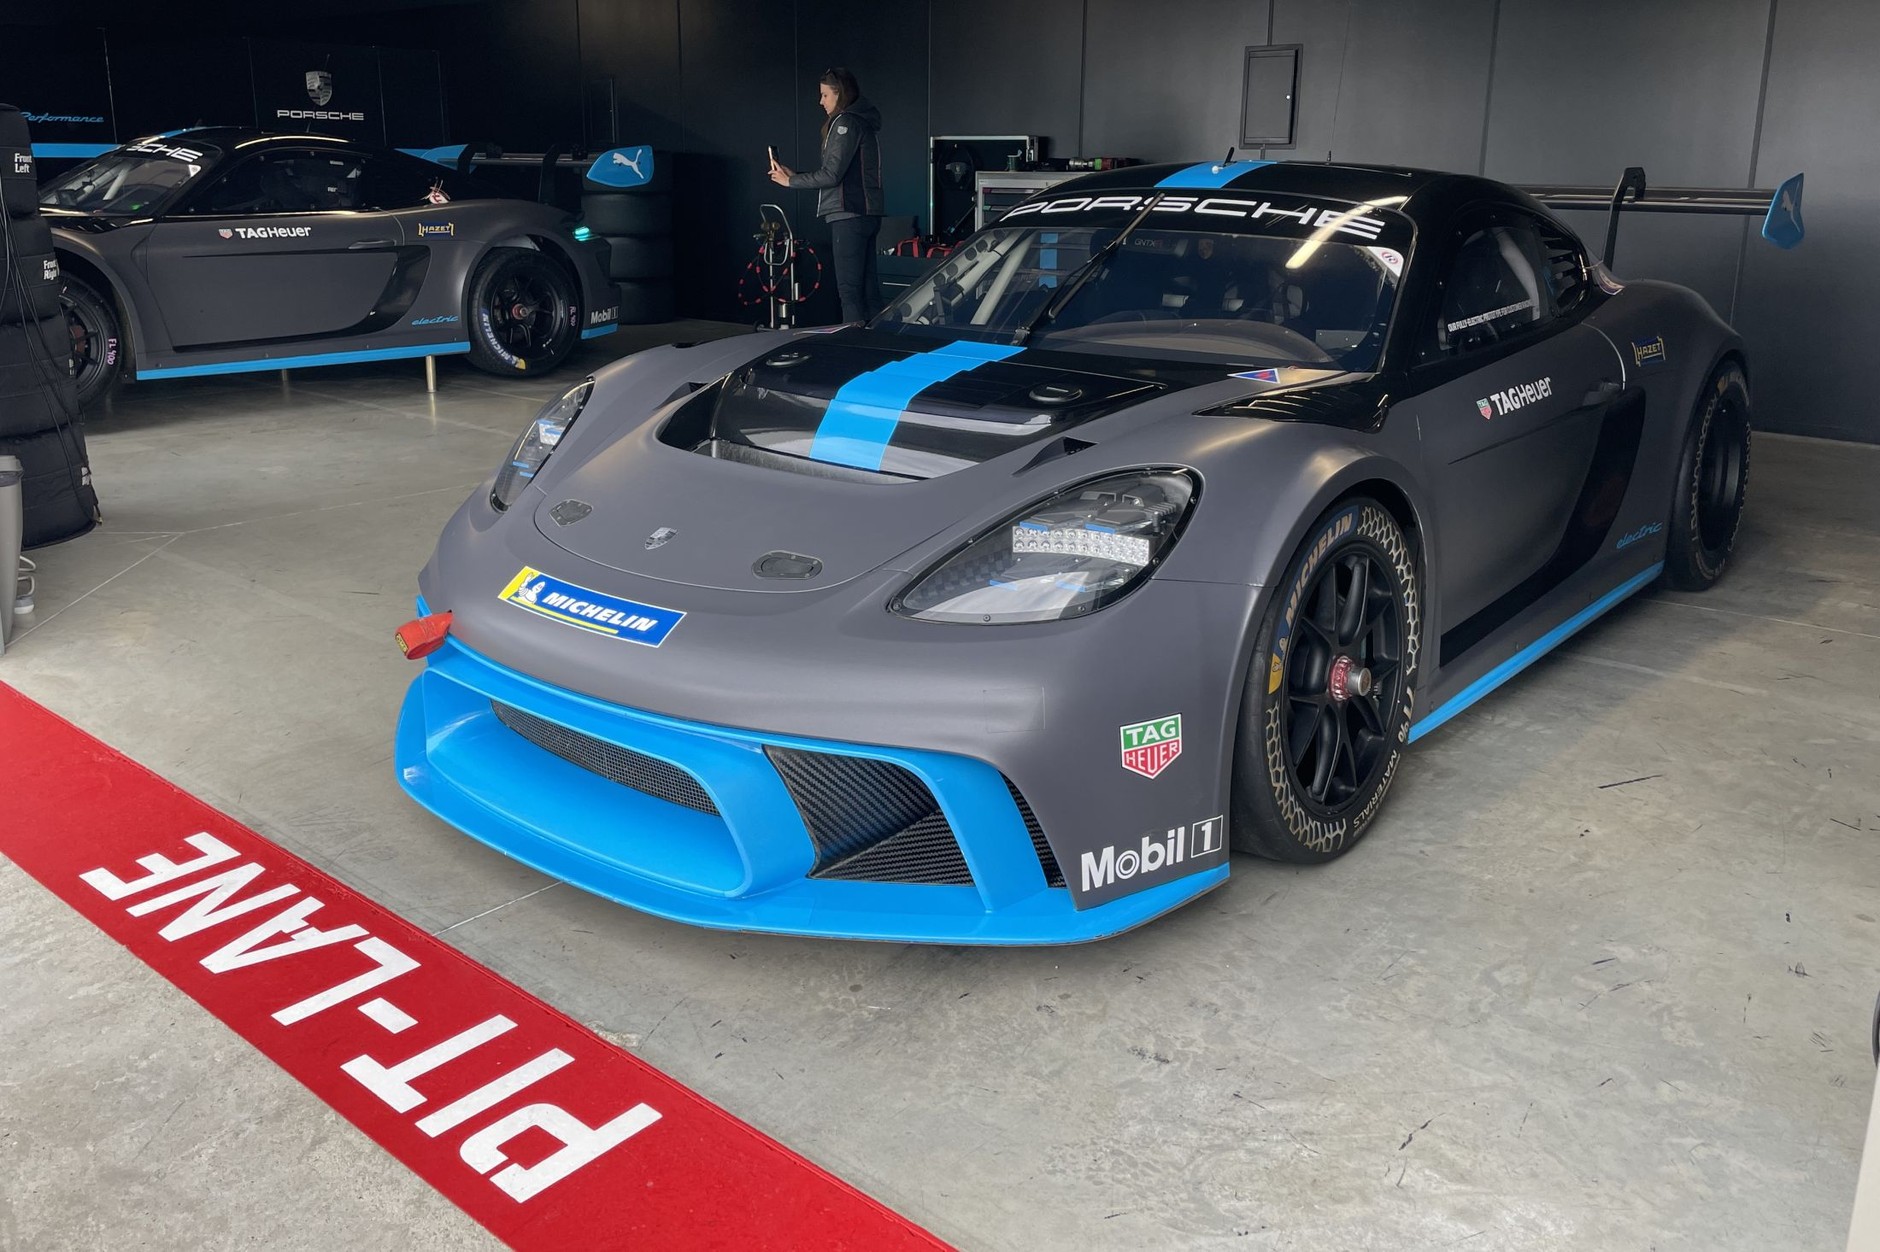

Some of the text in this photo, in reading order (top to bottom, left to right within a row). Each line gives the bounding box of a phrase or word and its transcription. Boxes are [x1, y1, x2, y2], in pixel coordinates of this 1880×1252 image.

[277, 109, 365, 121] PORSCHE
[14, 153, 32, 163] Front
[14, 163, 31, 174] Left
[234, 226, 312, 239] TAGHeuer
[420, 224, 452, 236] HAZET
[998, 196, 1386, 240] PORSCHE
[411, 315, 459, 326] electric
[590, 308, 612, 325] Mobil
[106, 337, 117, 366] FL 400
[482, 312, 513, 362] MICHELIN
[1634, 340, 1663, 363] HAZET
[1489, 376, 1552, 416] TAGHeuer
[1616, 520, 1664, 550] electric
[1285, 512, 1353, 630] MICHELIN
[541, 592, 660, 632] MICHELIN
[1125, 720, 1177, 746] TAG
[1126, 742, 1179, 774] HEUER
[1353, 750, 1398, 828] MATERIALS
[1081, 826, 1186, 892] Mobil
[79, 832, 663, 1203] PIT-LANE
